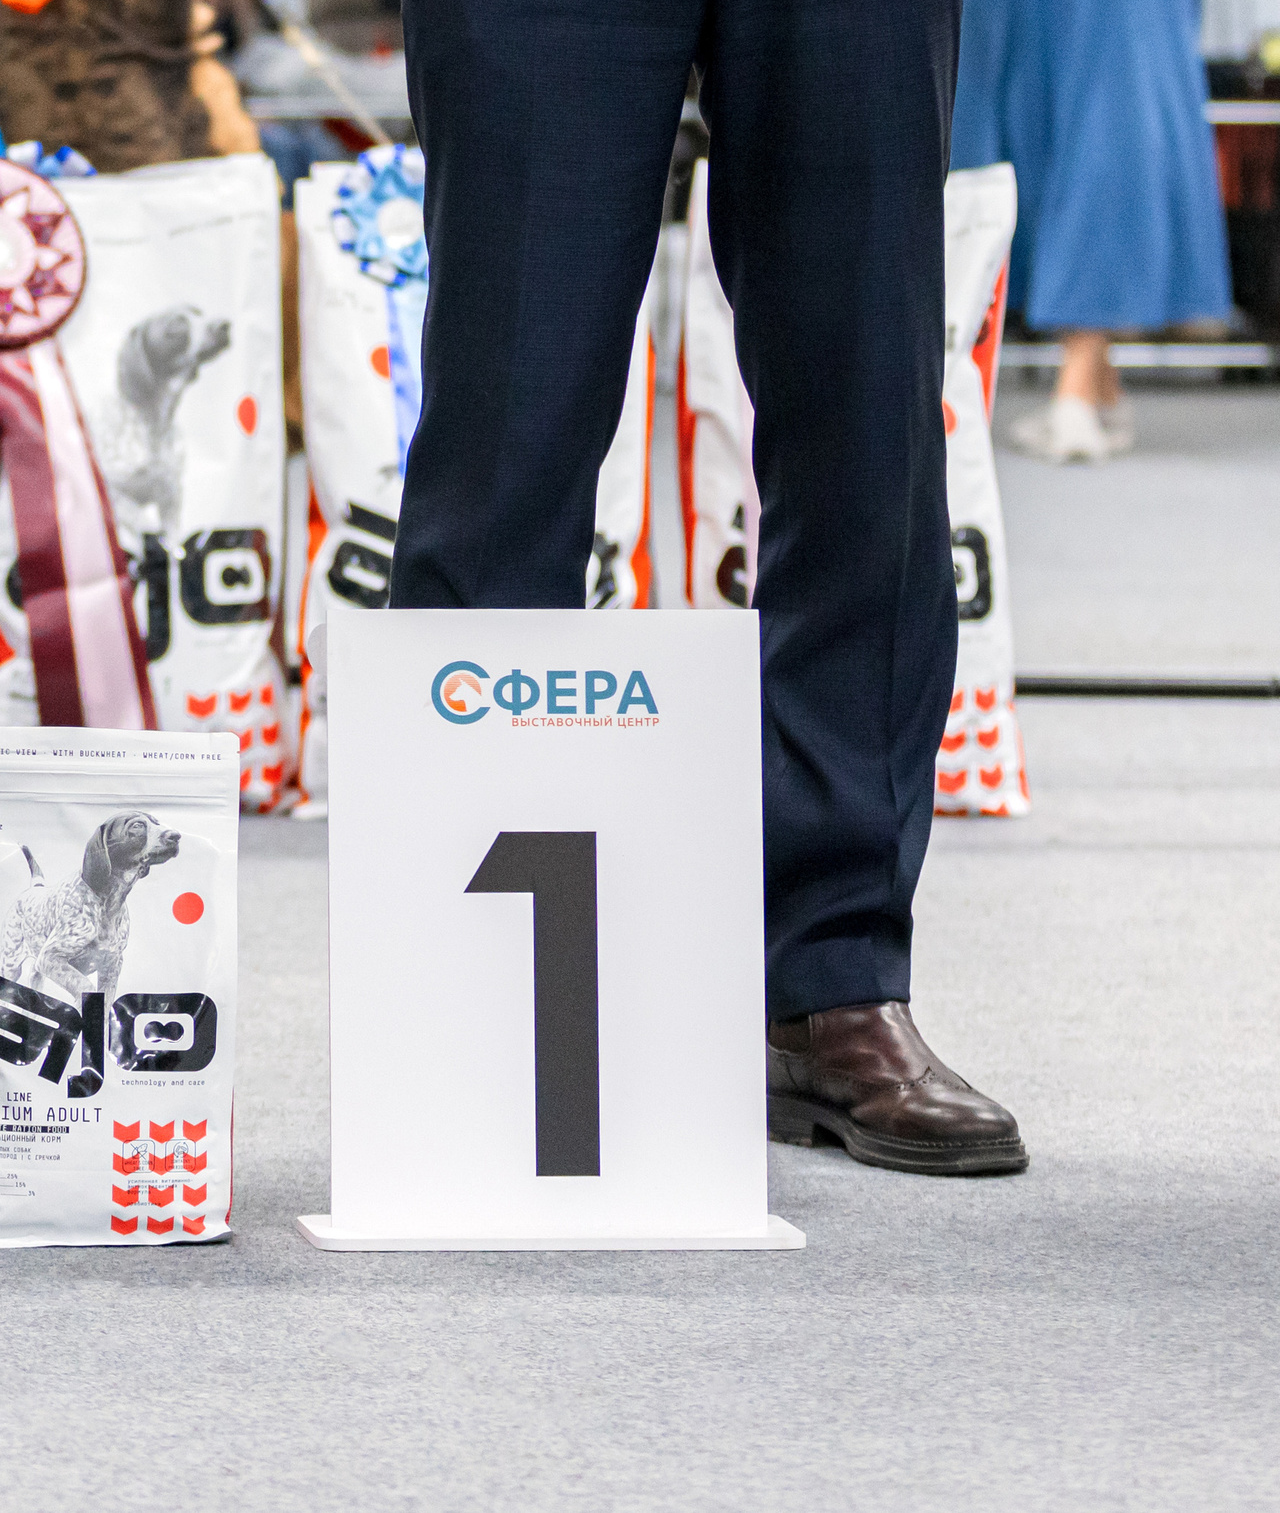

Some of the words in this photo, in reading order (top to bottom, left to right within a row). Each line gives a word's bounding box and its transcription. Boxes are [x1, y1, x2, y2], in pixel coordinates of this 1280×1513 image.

[431, 660, 660, 726] СФЕРА
[511, 715, 613, 728] ВЫСТАВОЧНЫЙ
[618, 717, 661, 729] ЦЕНТР
[52, 749, 75, 757] WITH
[79, 749, 127, 758] BUCKWHEAT
[142, 751, 196, 761] WHEAT/CORN
[201, 753, 222, 761] FREE
[463, 831, 601, 1177] 1
[121, 1078, 167, 1088] technology
[6, 1092, 33, 1102] LINE
[46, 1107, 103, 1123] ADULT
[12, 1125, 43, 1133] RATION
[47, 1126, 68, 1134] FOOD
[41, 1135, 62, 1143] КОРМ
